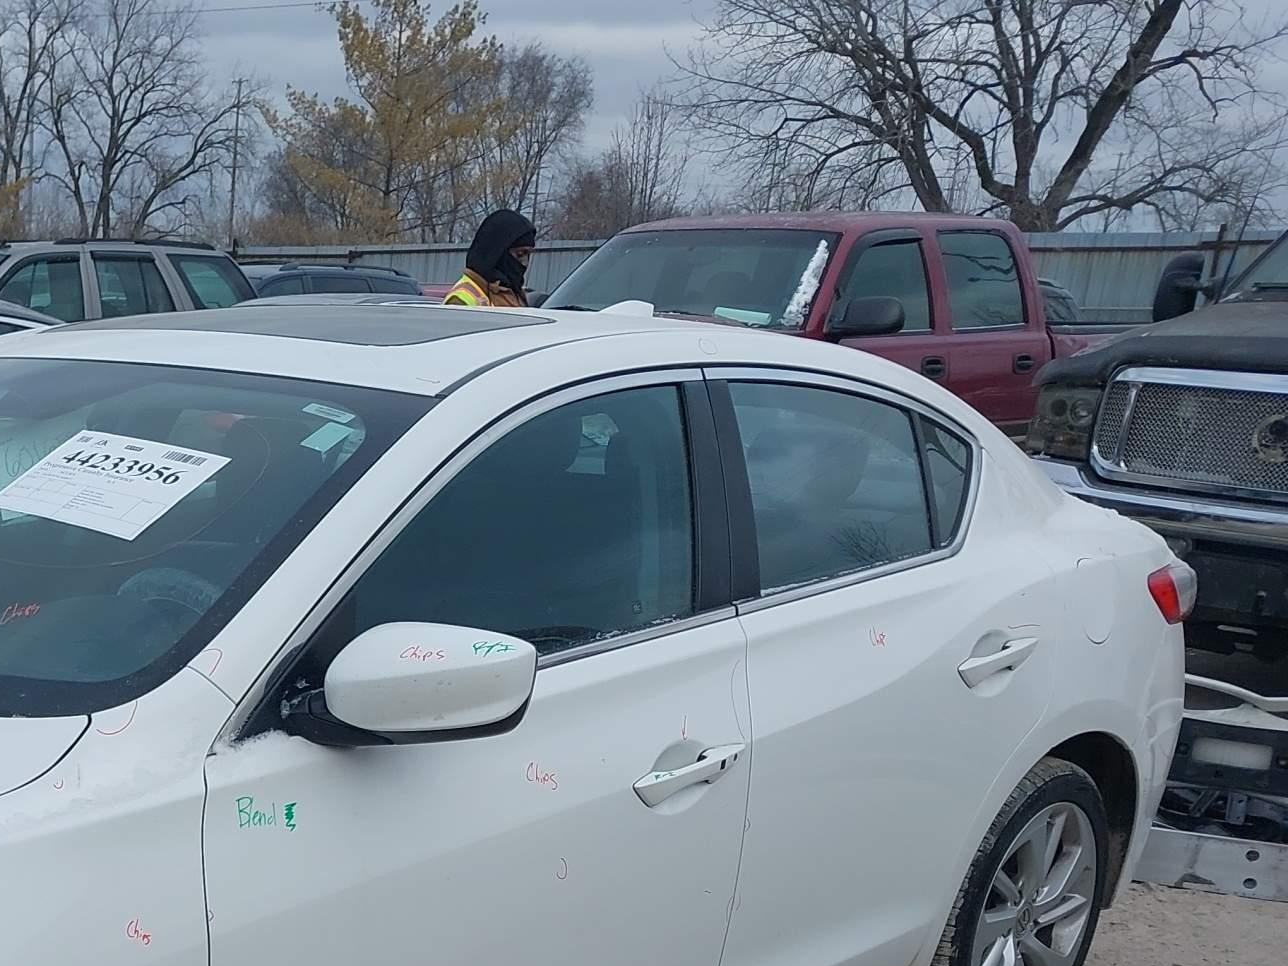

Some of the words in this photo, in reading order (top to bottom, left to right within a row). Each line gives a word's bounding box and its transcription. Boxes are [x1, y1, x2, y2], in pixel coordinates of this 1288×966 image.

[62, 449, 188, 485] 44233956
[399, 645, 445, 662] Chips
[235, 796, 277, 828] Blend
